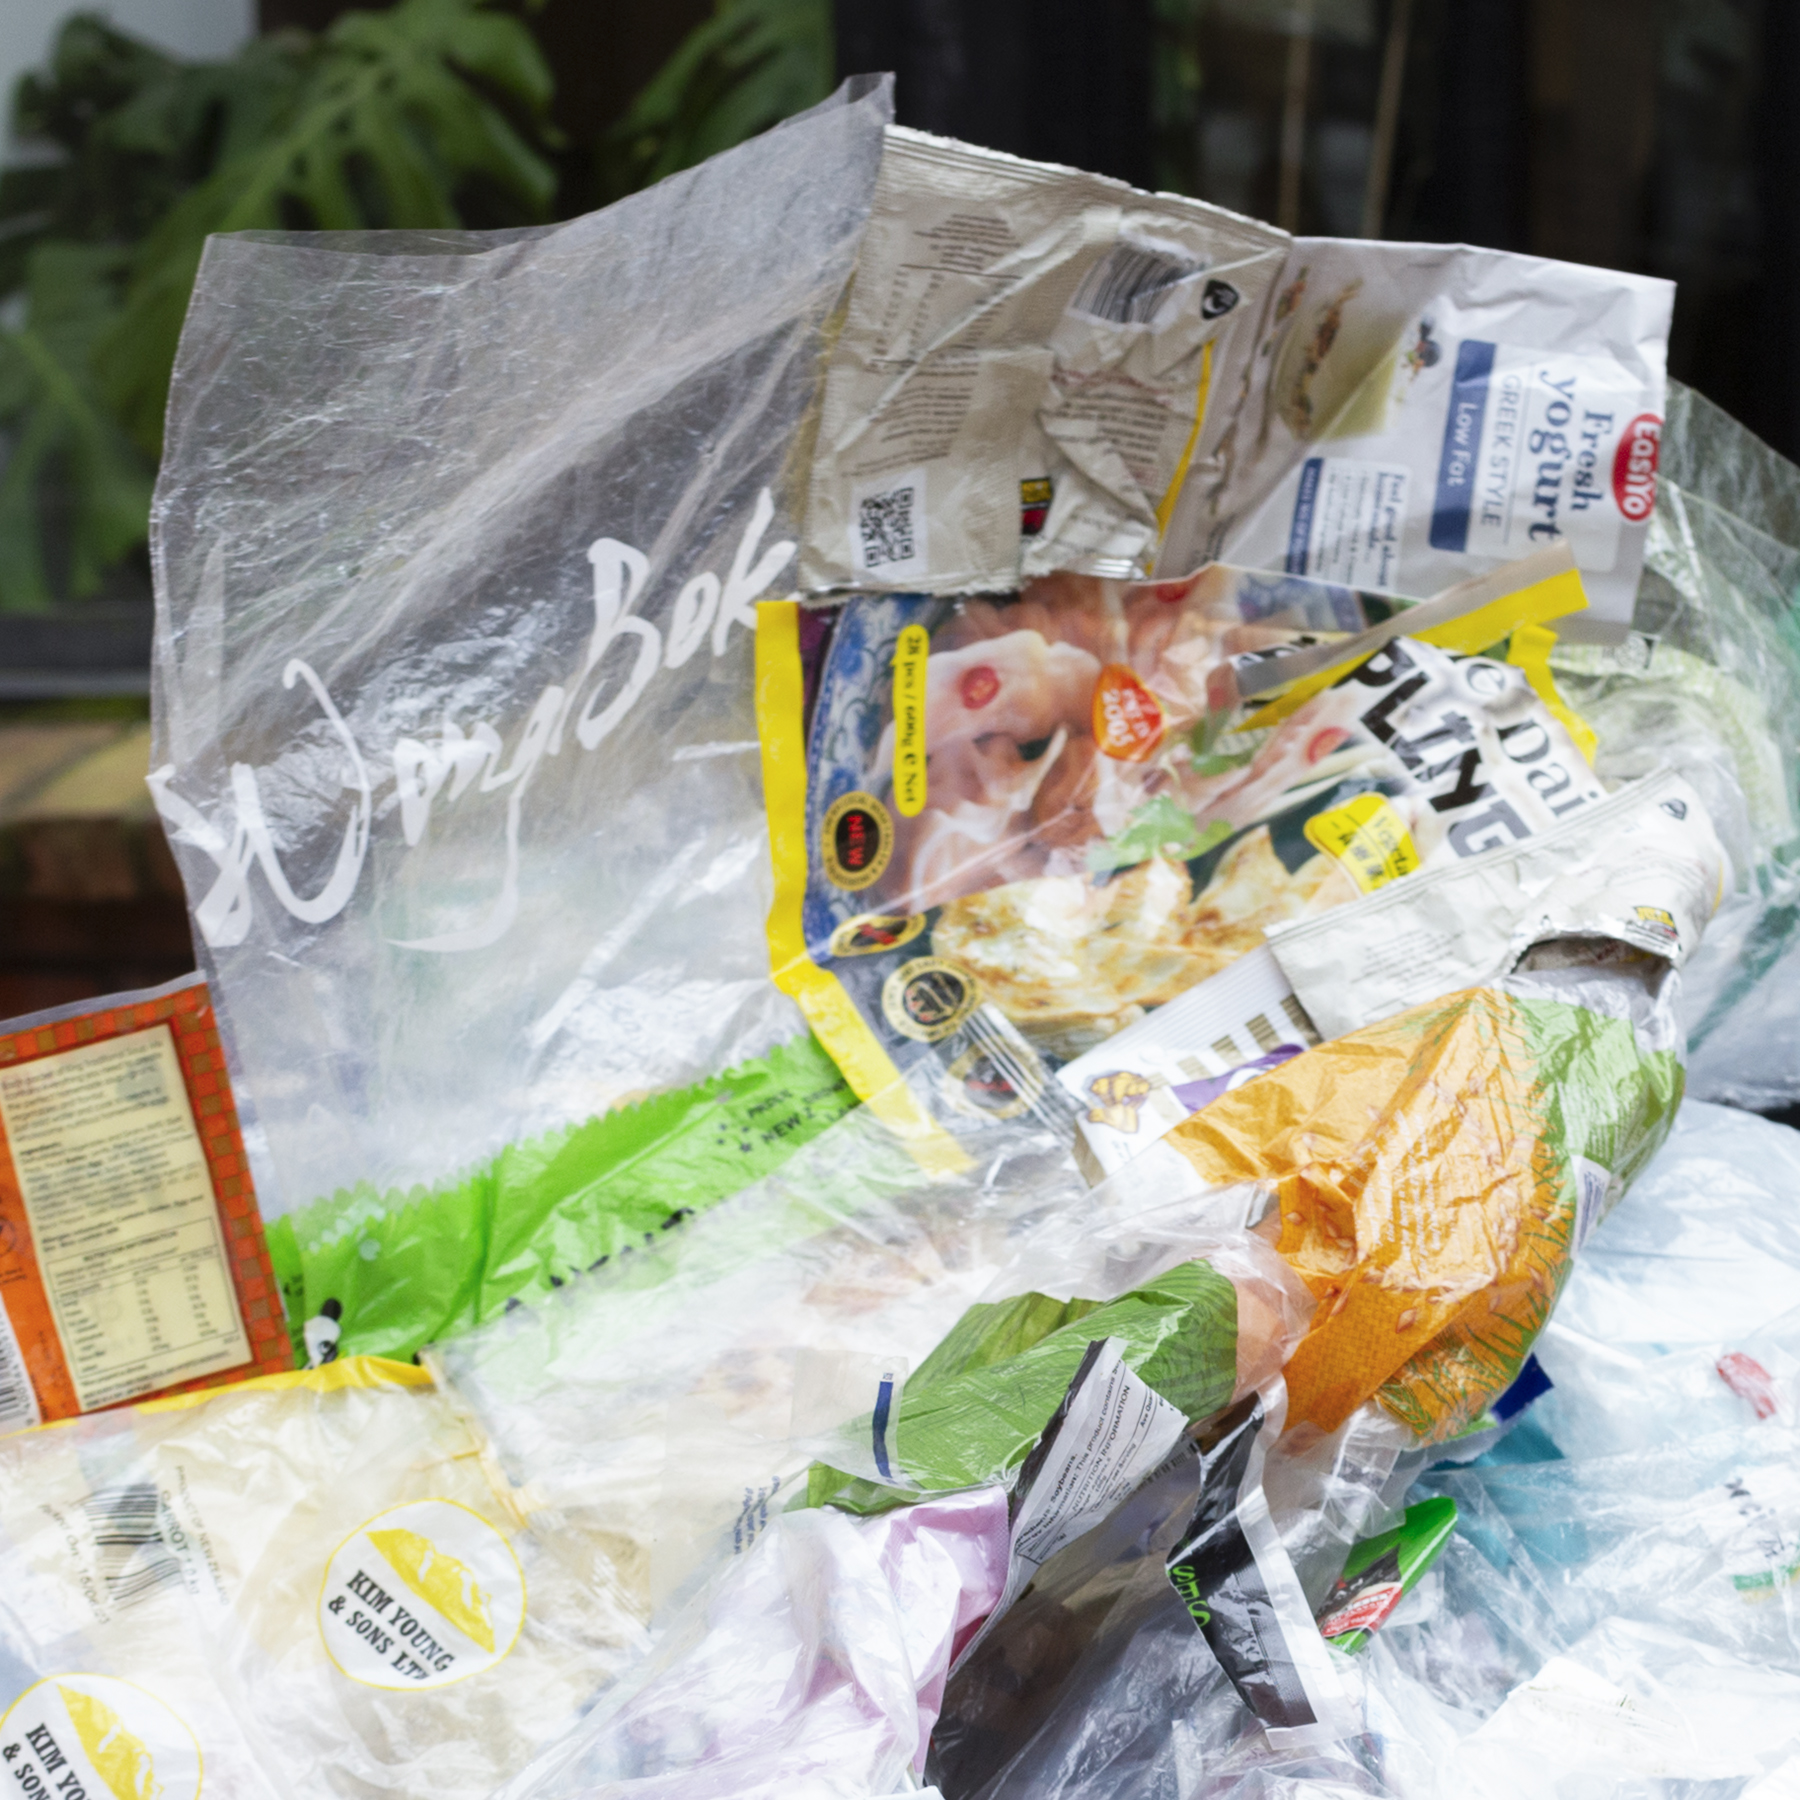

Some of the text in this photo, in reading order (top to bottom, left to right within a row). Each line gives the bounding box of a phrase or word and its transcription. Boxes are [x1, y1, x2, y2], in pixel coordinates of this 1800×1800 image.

[1446, 402, 1476, 487] Low Fat
[1479, 373, 1521, 528] GREEK STYLE
[1525, 370, 1582, 545] yogurt
[1569, 408, 1614, 515] Fresh
[844, 815, 867, 866] NEW
[1073, 1386, 1131, 1512] NUTRITION INFORMATION
[1075, 1452, 1089, 1471] This
[1088, 1417, 1107, 1453] product
[1098, 1377, 1116, 1416] contains
[154, 1489, 189, 1555] CARROT
[1050, 1453, 1078, 1503] Soybeans.
[171, 1464, 231, 1606] PRODUCT OF NEW ZEALAND
[327, 1595, 347, 1615] &
[347, 1609, 395, 1655] SONS
[346, 1569, 456, 1672] KIM YOUNG
[1, 1742, 23, 1762] &
[25, 1722, 69, 1769] KIM
